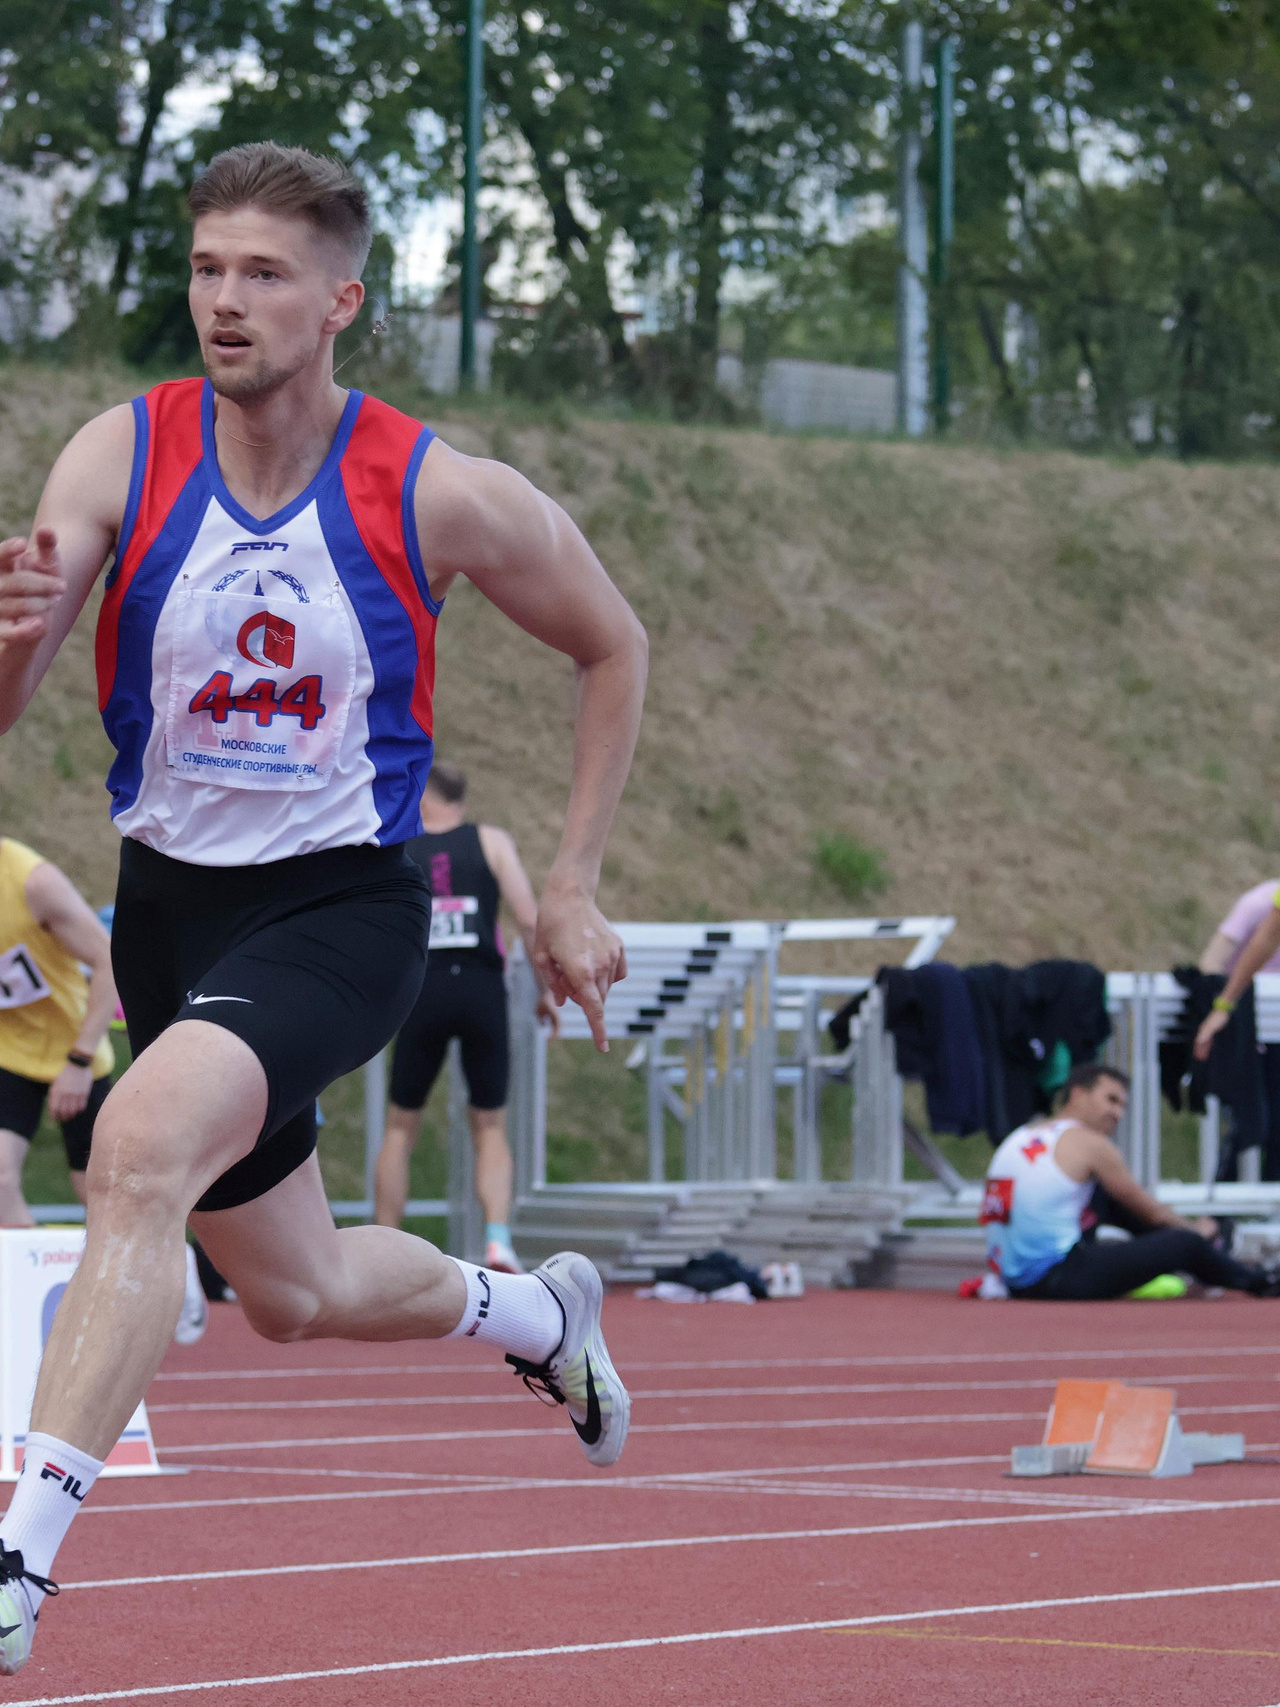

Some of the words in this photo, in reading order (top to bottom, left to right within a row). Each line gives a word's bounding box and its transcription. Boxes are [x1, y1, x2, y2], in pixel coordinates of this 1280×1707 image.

[189, 670, 326, 730] 444
[221, 738, 287, 755] МОСКОВСКИЕ
[182, 752, 242, 769] СТУДЕНЧЕСКИЕ
[243, 760, 299, 773] СПОРТИВНЫЕ
[42, 1247, 85, 1268] polan
[40, 1461, 87, 1502] FIL
